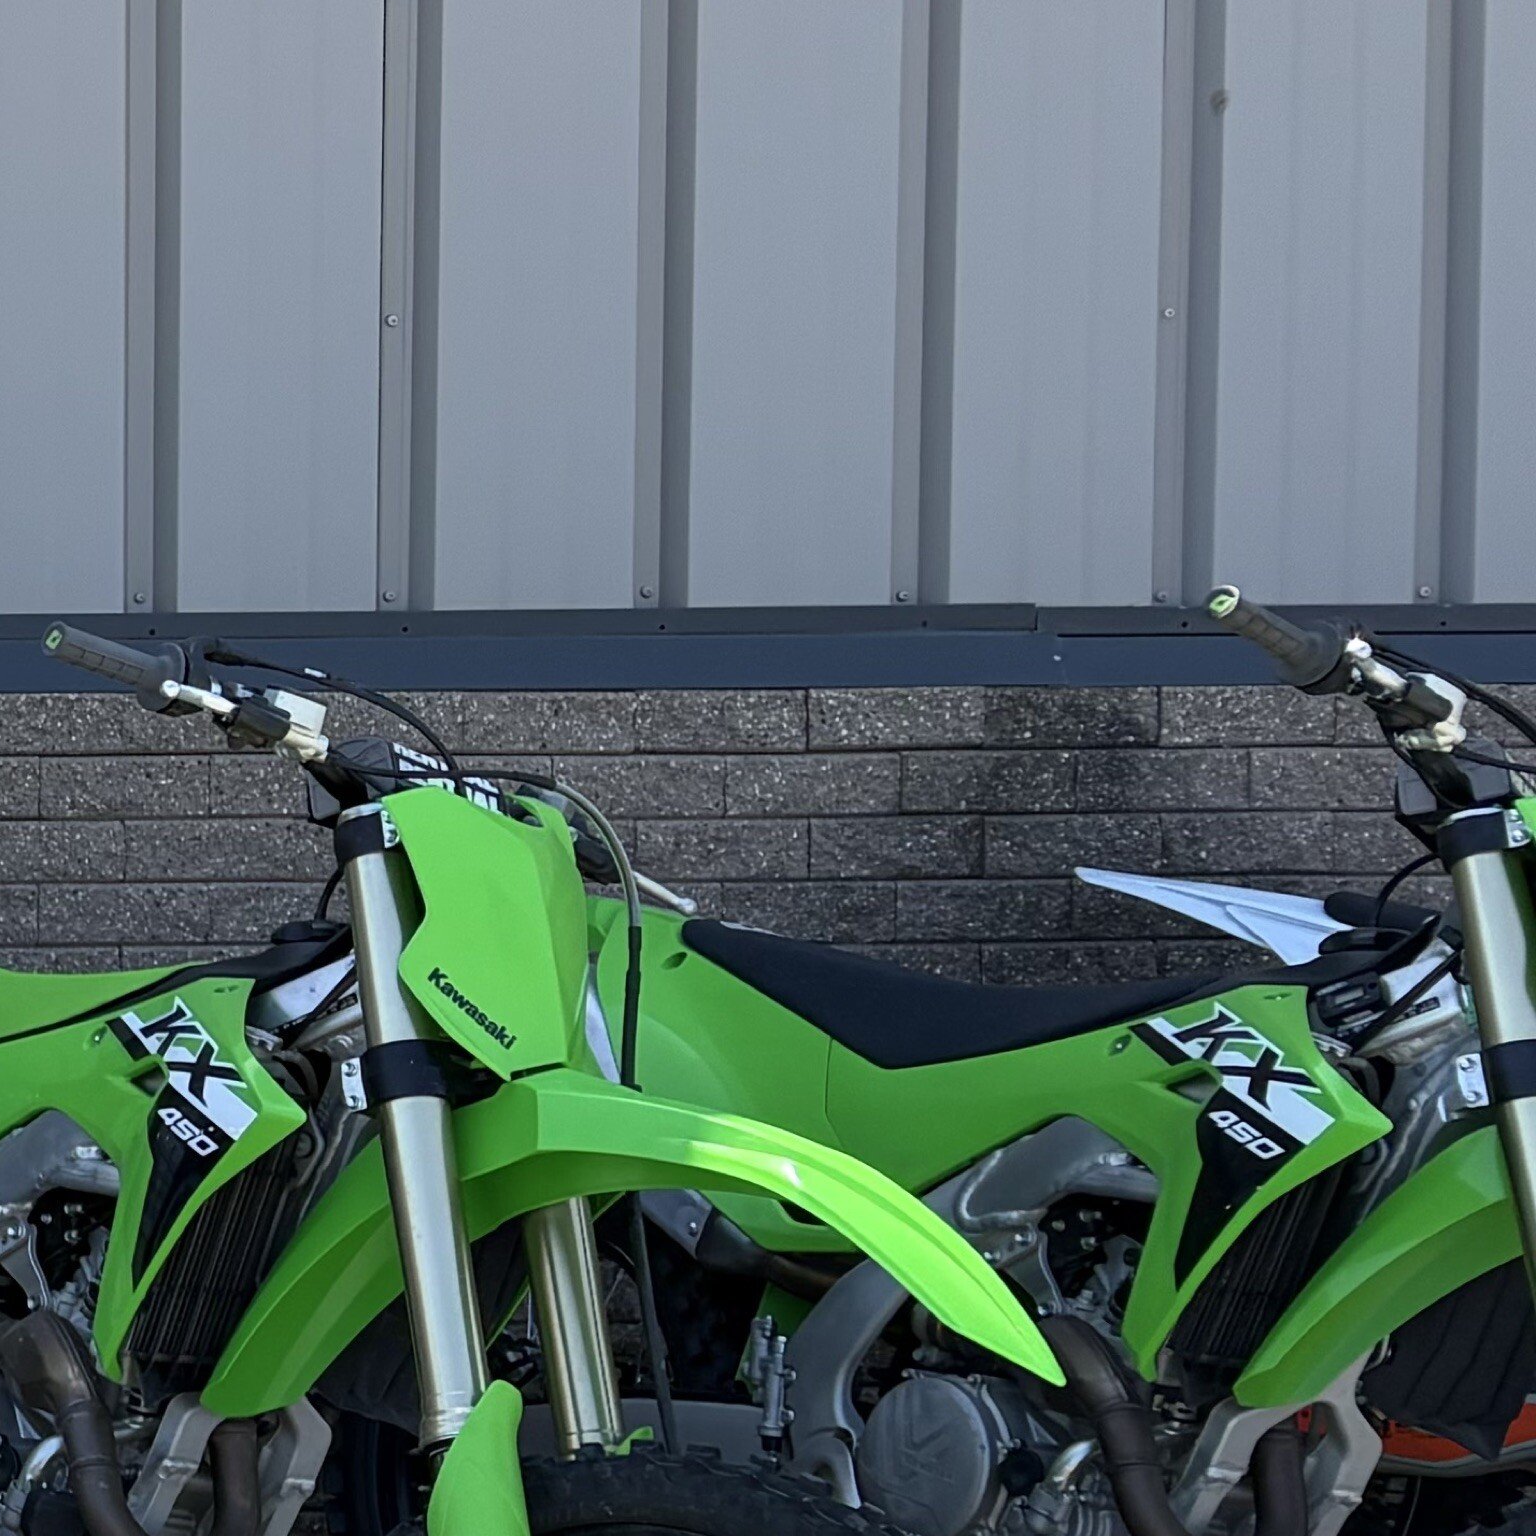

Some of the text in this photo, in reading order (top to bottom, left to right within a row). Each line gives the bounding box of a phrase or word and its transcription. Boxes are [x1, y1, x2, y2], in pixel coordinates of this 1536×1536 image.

[427, 966, 518, 1051] Kawasaki
[137, 996, 248, 1109] KX
[1170, 1001, 1324, 1113] KX
[157, 1107, 220, 1156] 450
[1207, 1110, 1287, 1160] 450
